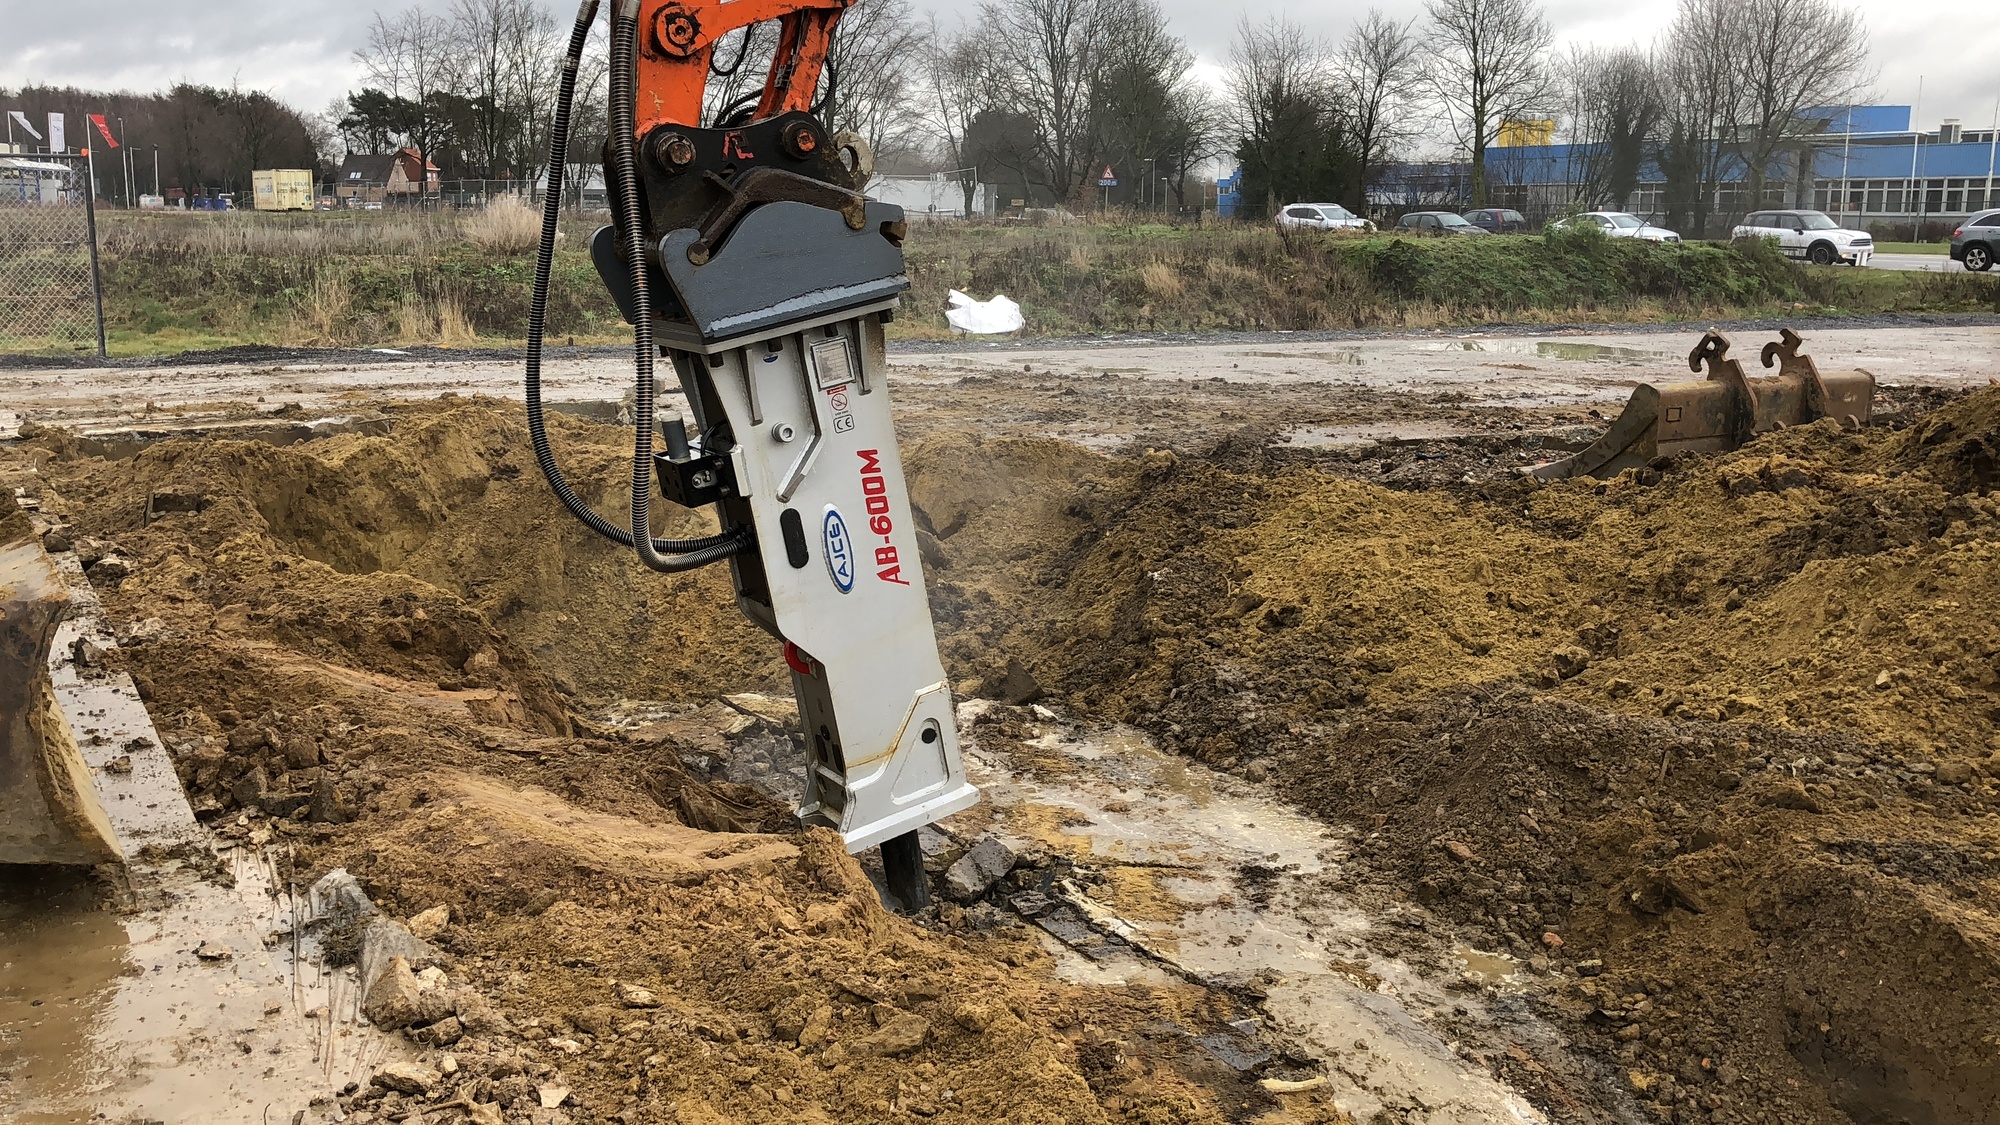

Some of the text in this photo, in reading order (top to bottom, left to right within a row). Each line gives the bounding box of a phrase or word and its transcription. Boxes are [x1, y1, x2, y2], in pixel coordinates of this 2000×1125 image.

[836, 417, 852, 430] CE
[857, 449, 910, 586] AB-600M
[829, 522, 849, 577] AJCE
